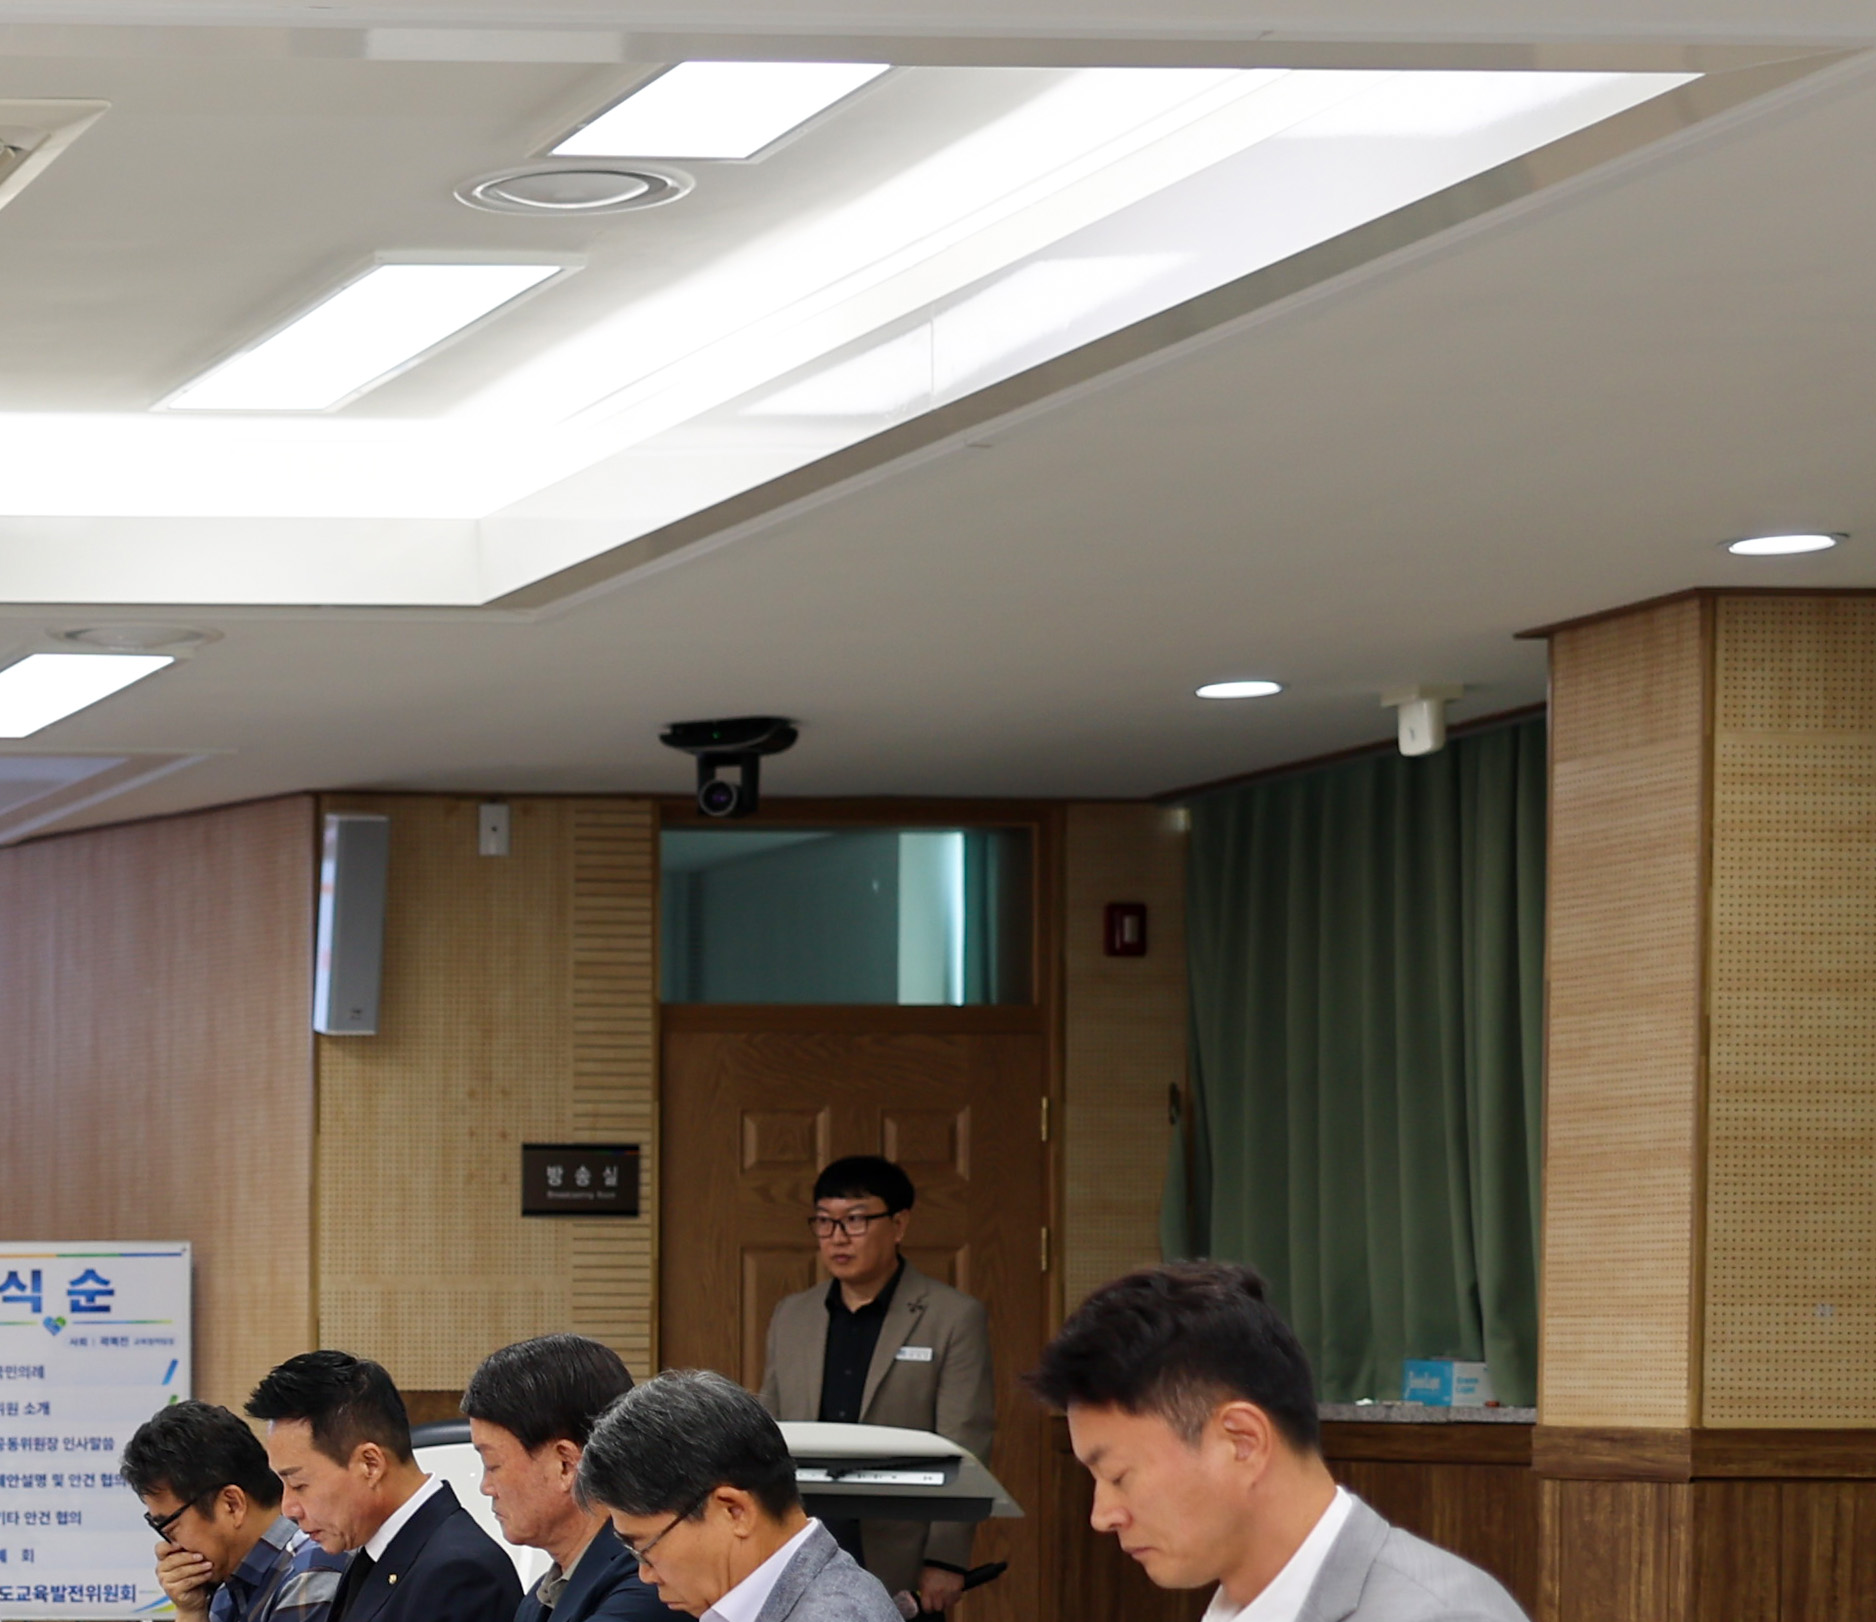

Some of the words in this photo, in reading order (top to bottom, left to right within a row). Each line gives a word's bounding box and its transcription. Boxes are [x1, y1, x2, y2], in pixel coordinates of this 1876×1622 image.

[25, 1401, 50, 1415] 소개
[63, 1437, 114, 1451] 인사말씀
[52, 1474, 64, 1487] 및
[68, 1473, 95, 1488] 안건
[24, 1511, 50, 1525] 안건
[56, 1511, 81, 1525] 협의
